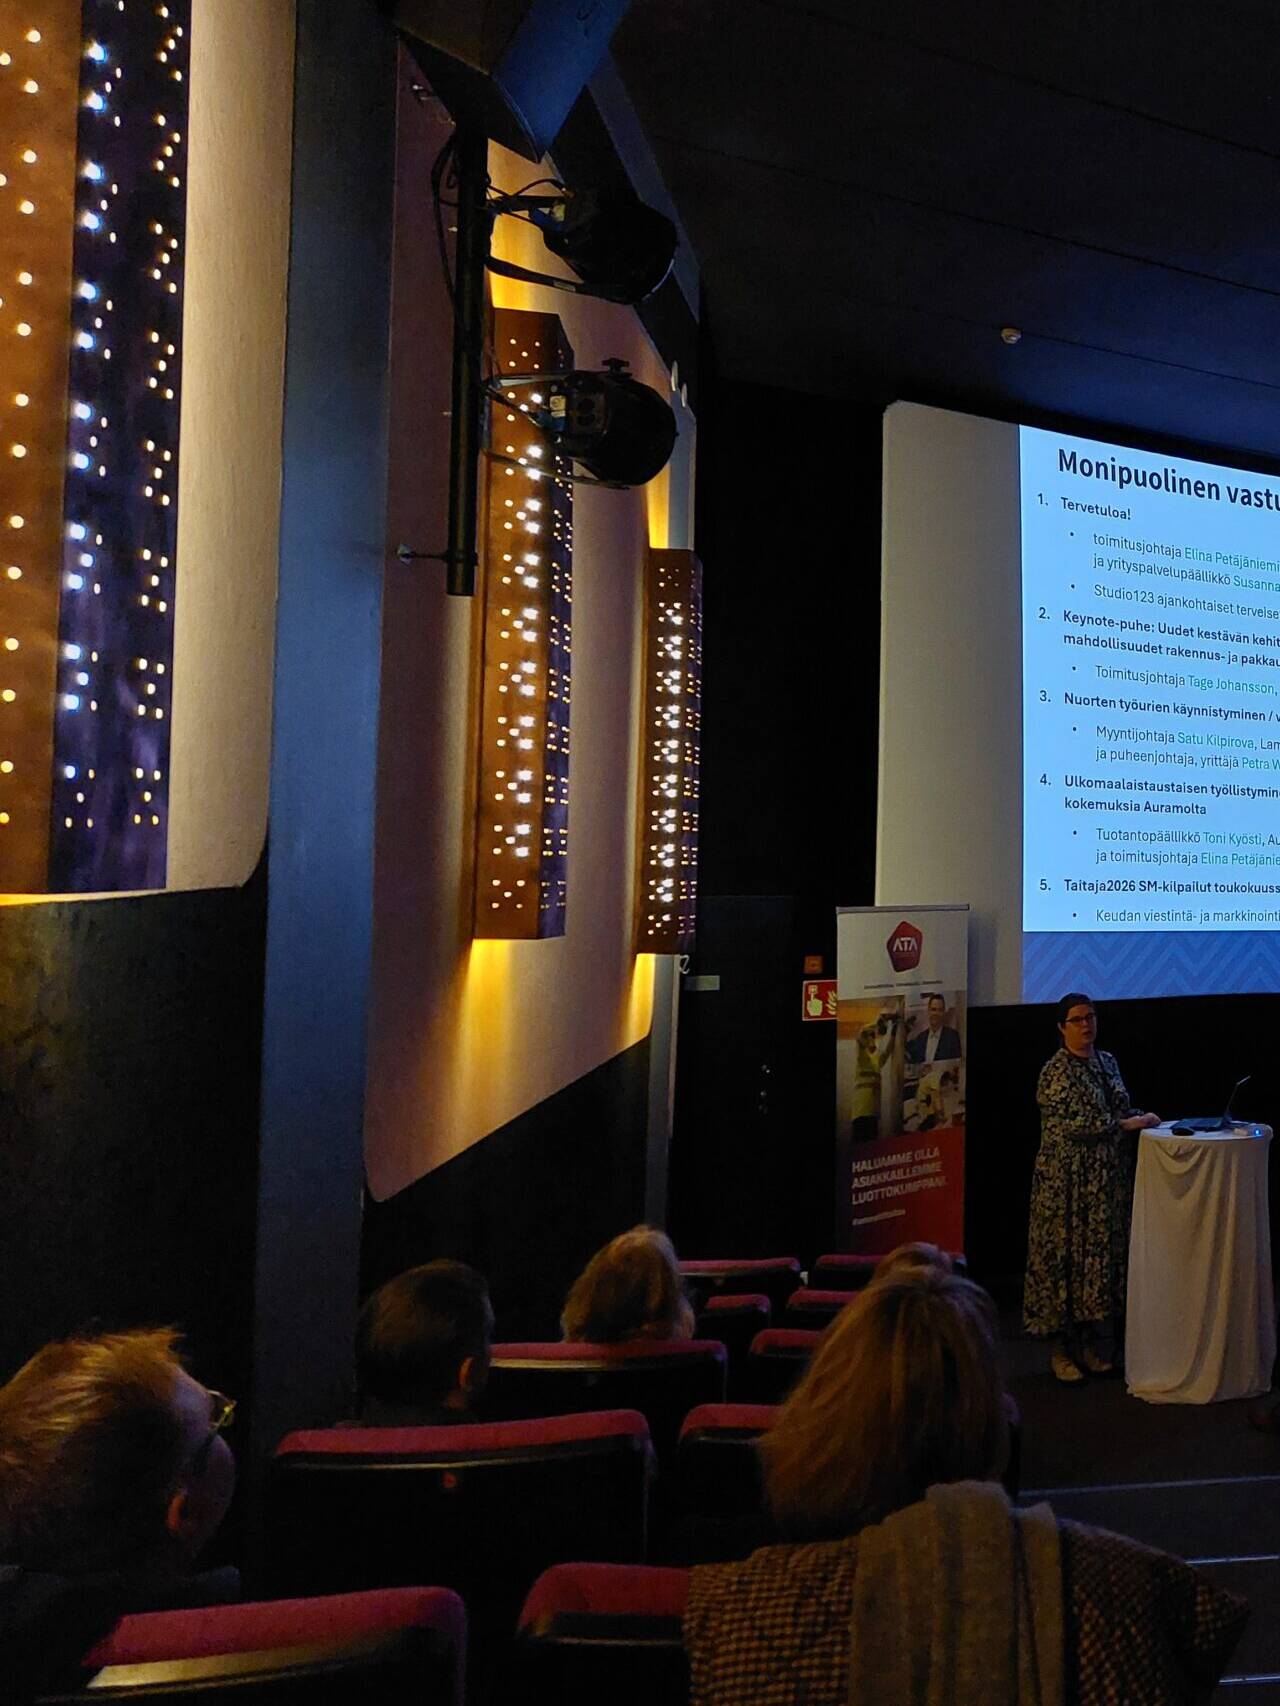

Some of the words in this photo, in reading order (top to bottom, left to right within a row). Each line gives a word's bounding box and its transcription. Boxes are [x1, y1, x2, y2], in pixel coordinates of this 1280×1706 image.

[1058, 449, 1220, 500] Monipuolinen
[1037, 492, 1049, 506] 1.
[1060, 496, 1132, 520] Tervetuloa!
[1093, 533, 1182, 560] toimitusjohtaja
[1184, 546, 1212, 563] Elina
[1093, 552, 1104, 569] ja
[1107, 556, 1231, 585] yrityspalvelupäällikkö
[1233, 574, 1280, 592] Susanna
[1094, 583, 1154, 604] Studio123
[1157, 592, 1233, 614] ajankohtaiset
[1038, 606, 1050, 620] 2.
[1063, 609, 1155, 633] Keynote-puhe:
[1157, 621, 1195, 638] Uudet
[1197, 626, 1250, 644] kestävän
[1063, 633, 1163, 655] mahdollisuudet
[1165, 645, 1225, 661] rakennus-
[1227, 650, 1238, 665] ja
[1095, 664, 1186, 688] Toimitusjohtaja
[1188, 674, 1214, 691] Tage
[1216, 677, 1278, 696] Johansson,
[1039, 689, 1051, 703] 3.
[1064, 691, 1117, 708] Nuorten
[1118, 698, 1170, 713] työurien
[1172, 702, 1265, 721] käynnistyminen
[1267, 709, 1273, 722] /
[1096, 725, 1175, 745] Myyntijohtaja
[1177, 731, 1204, 745] Satu
[1206, 733, 1258, 751] Kilpirova,
[1095, 745, 1107, 762] ja
[1110, 748, 1198, 767] puheenjohtaja,
[1200, 754, 1240, 770] yrittäjä
[1242, 756, 1269, 770] Petra
[1039, 772, 1052, 786] 4.
[1064, 774, 1208, 794] Ulkomaalaistaustaisen
[1064, 796, 1141, 812] kokemuksia
[1144, 800, 1206, 815] Auramolta
[1096, 827, 1200, 844] Tuotantopäällikkö
[1203, 830, 1226, 844] Toni
[1228, 832, 1265, 847] Kyösti,
[1095, 848, 1107, 865] ja
[1110, 849, 1198, 866] toimitusjohtaja
[1201, 851, 1229, 865] Elina
[1039, 878, 1052, 891] 5.
[1064, 878, 1136, 894] Taitaja2026
[1138, 879, 1211, 895] SM-kilpailut
[1096, 908, 1141, 922] Keudan
[1143, 908, 1197, 922] viestintä-
[1199, 908, 1211, 925] ja
[893, 937, 918, 952] ATA
[852, 1151, 912, 1173] HALUAMME
[914, 1147, 940, 1160] OLLA
